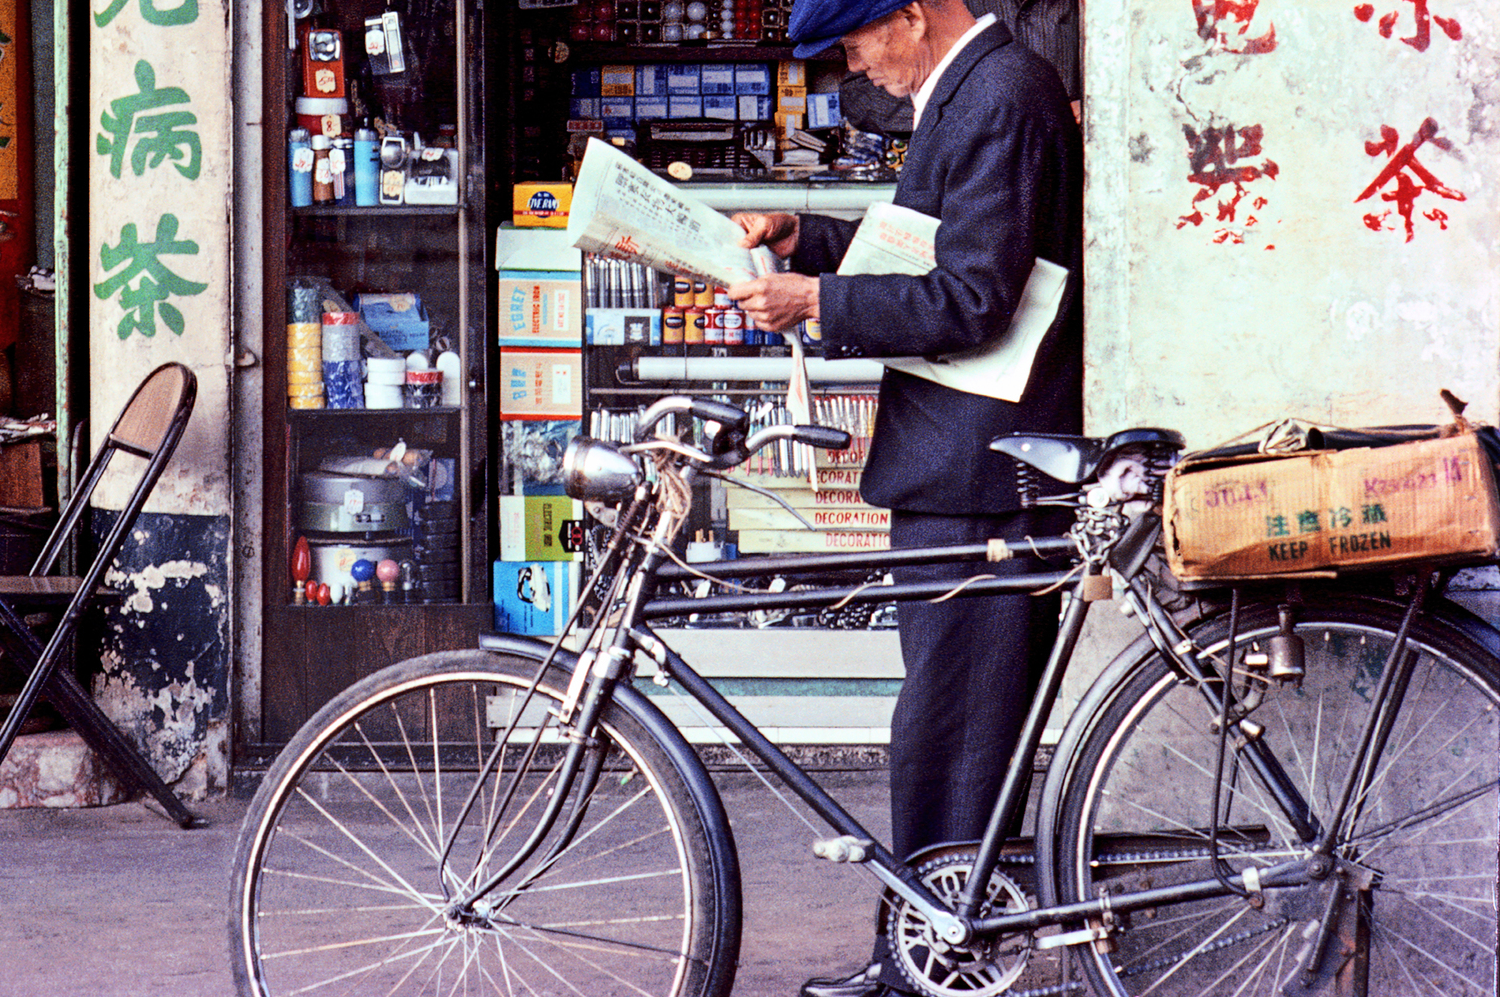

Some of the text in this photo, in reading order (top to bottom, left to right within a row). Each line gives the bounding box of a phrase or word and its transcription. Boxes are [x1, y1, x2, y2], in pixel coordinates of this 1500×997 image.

[509, 286, 527, 332] EGRET
[814, 512, 889, 525] DECORATION
[1268, 530, 1392, 561] KEEP FROZEN
